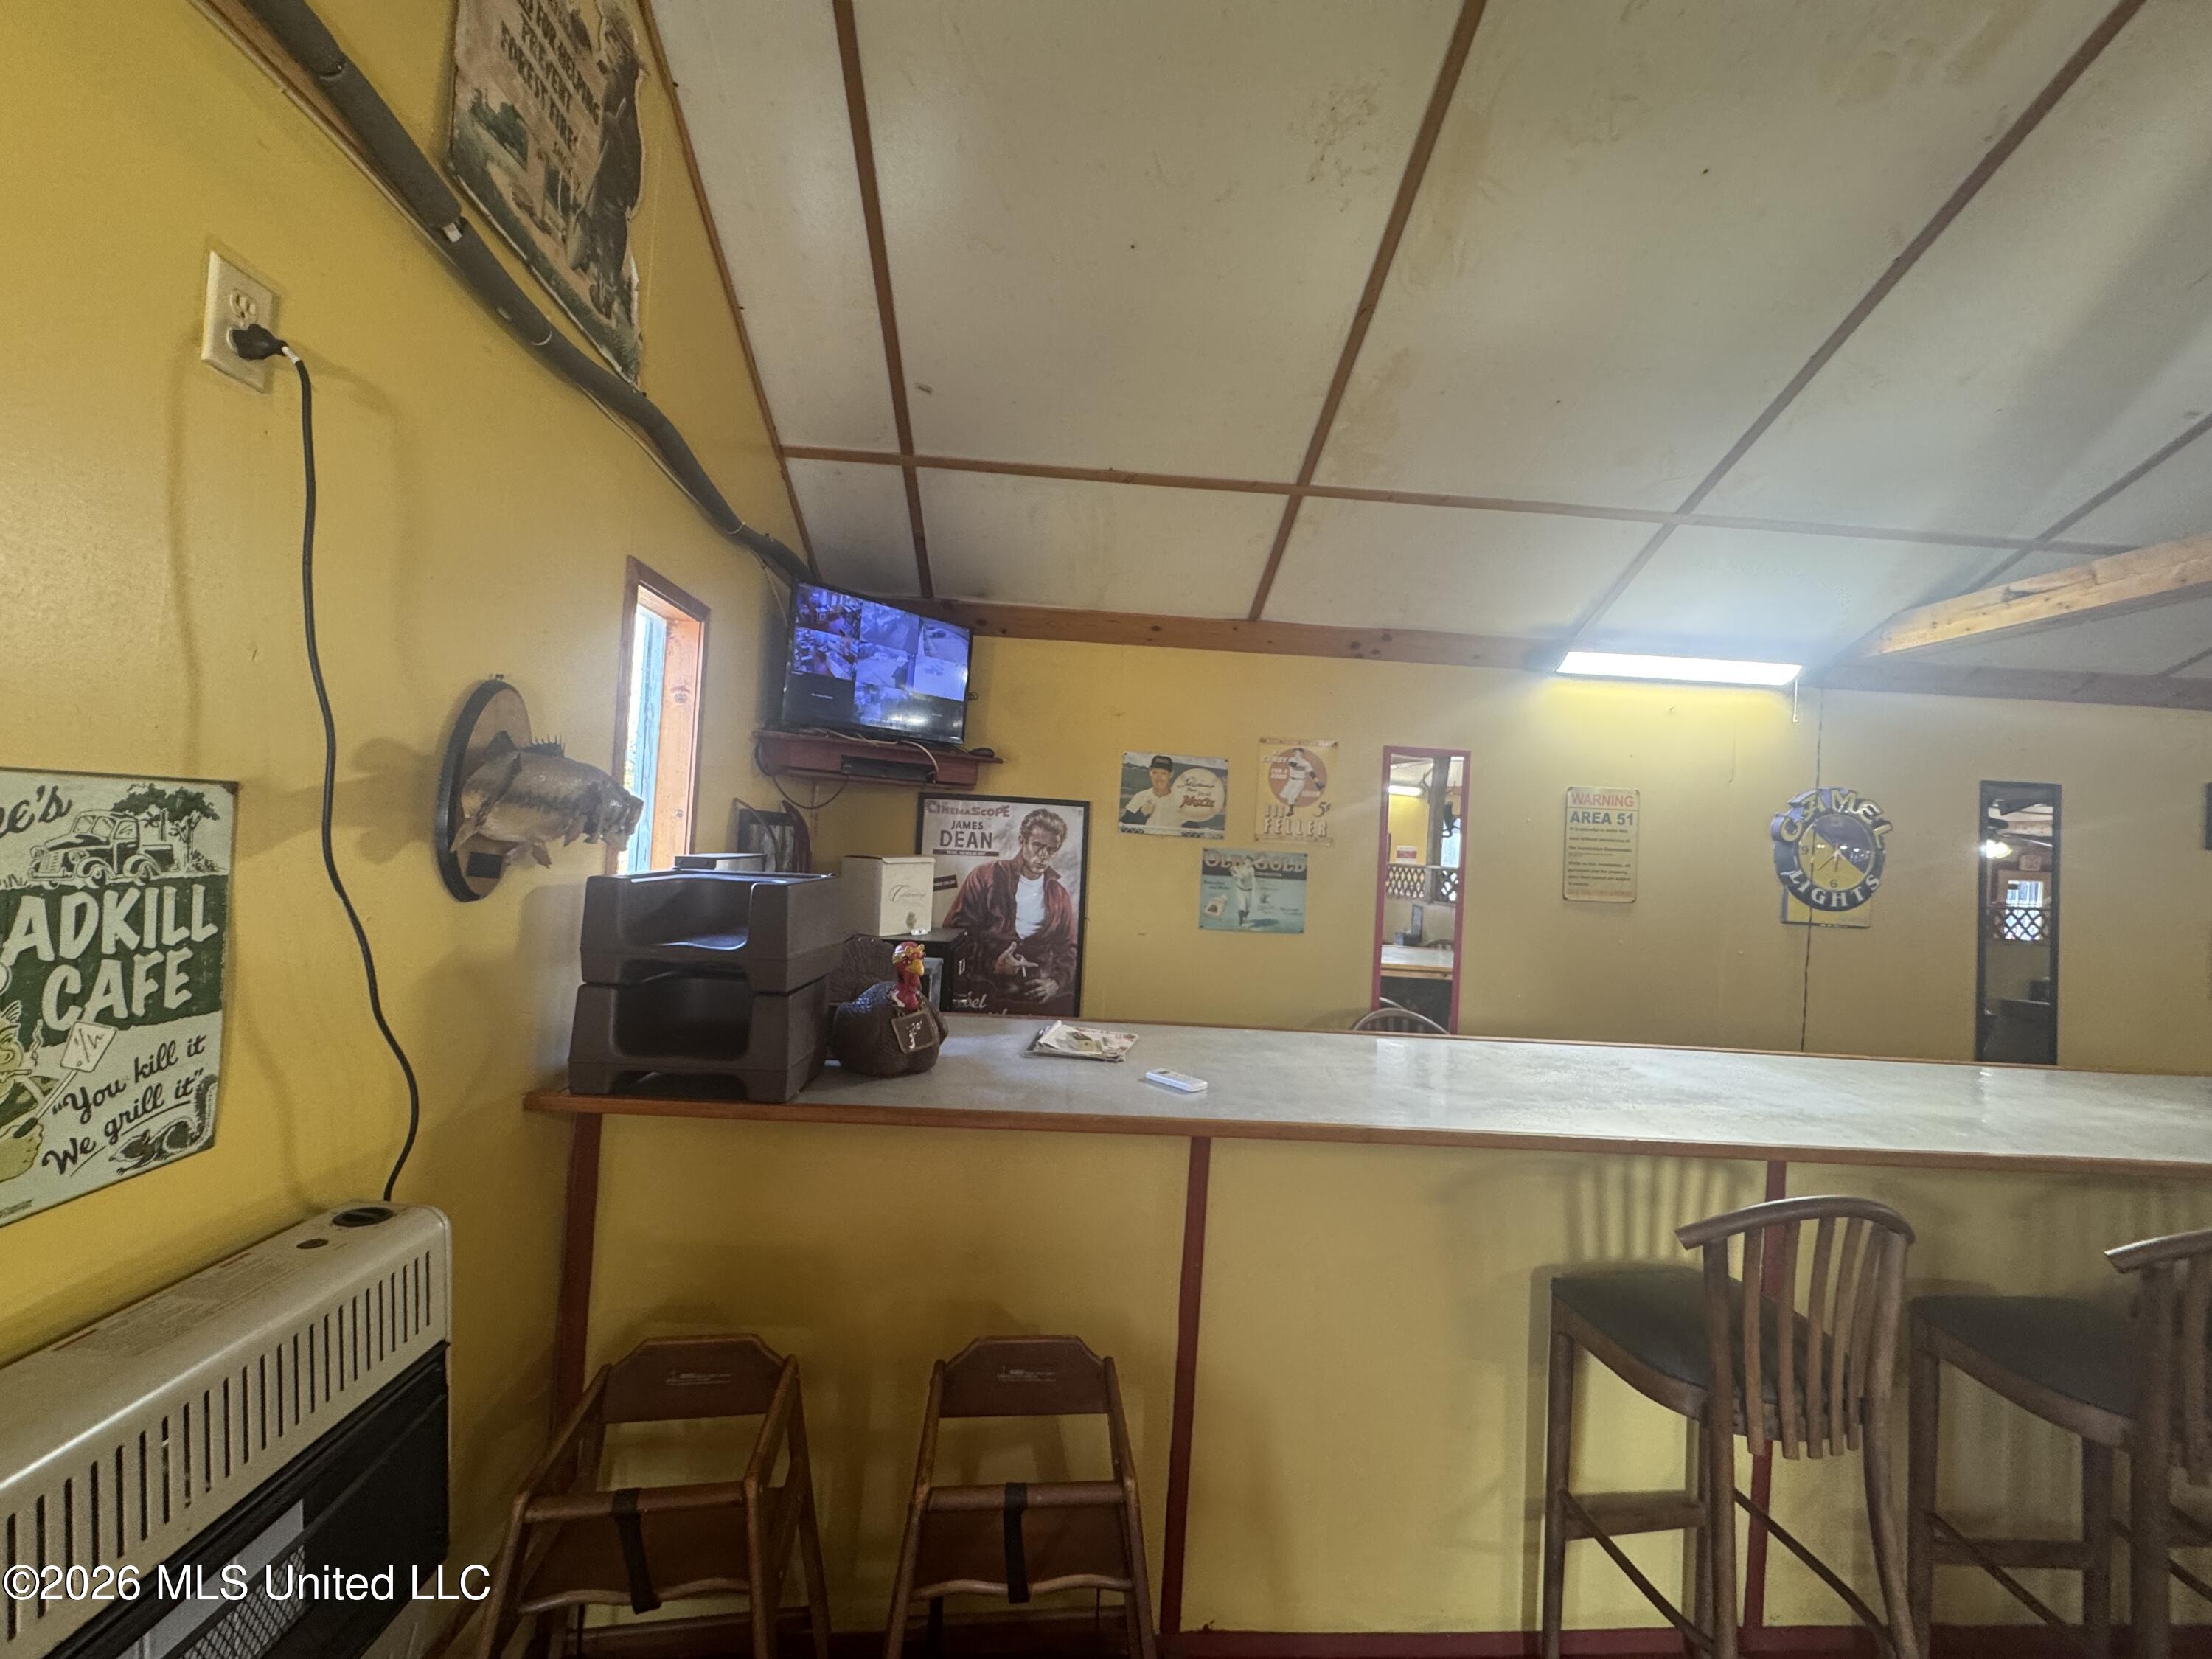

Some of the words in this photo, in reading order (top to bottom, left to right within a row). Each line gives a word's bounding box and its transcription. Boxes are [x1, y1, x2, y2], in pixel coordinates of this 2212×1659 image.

[0, 785, 72, 838] e's
[1571, 792, 1634, 807] WARNING
[950, 820, 984, 830] JAMES
[1570, 811, 1612, 825] AREA
[1617, 813, 1634, 826] 51
[939, 830, 992, 849] DEAN
[1788, 869, 1879, 908] LIGHTS
[1829, 879, 1838, 888] 6
[42, 947, 193, 1032] CAFE
[133, 1040, 178, 1084] kill
[187, 1034, 206, 1058] it
[41, 1137, 97, 1175] We
[104, 1082, 164, 1145] grill
